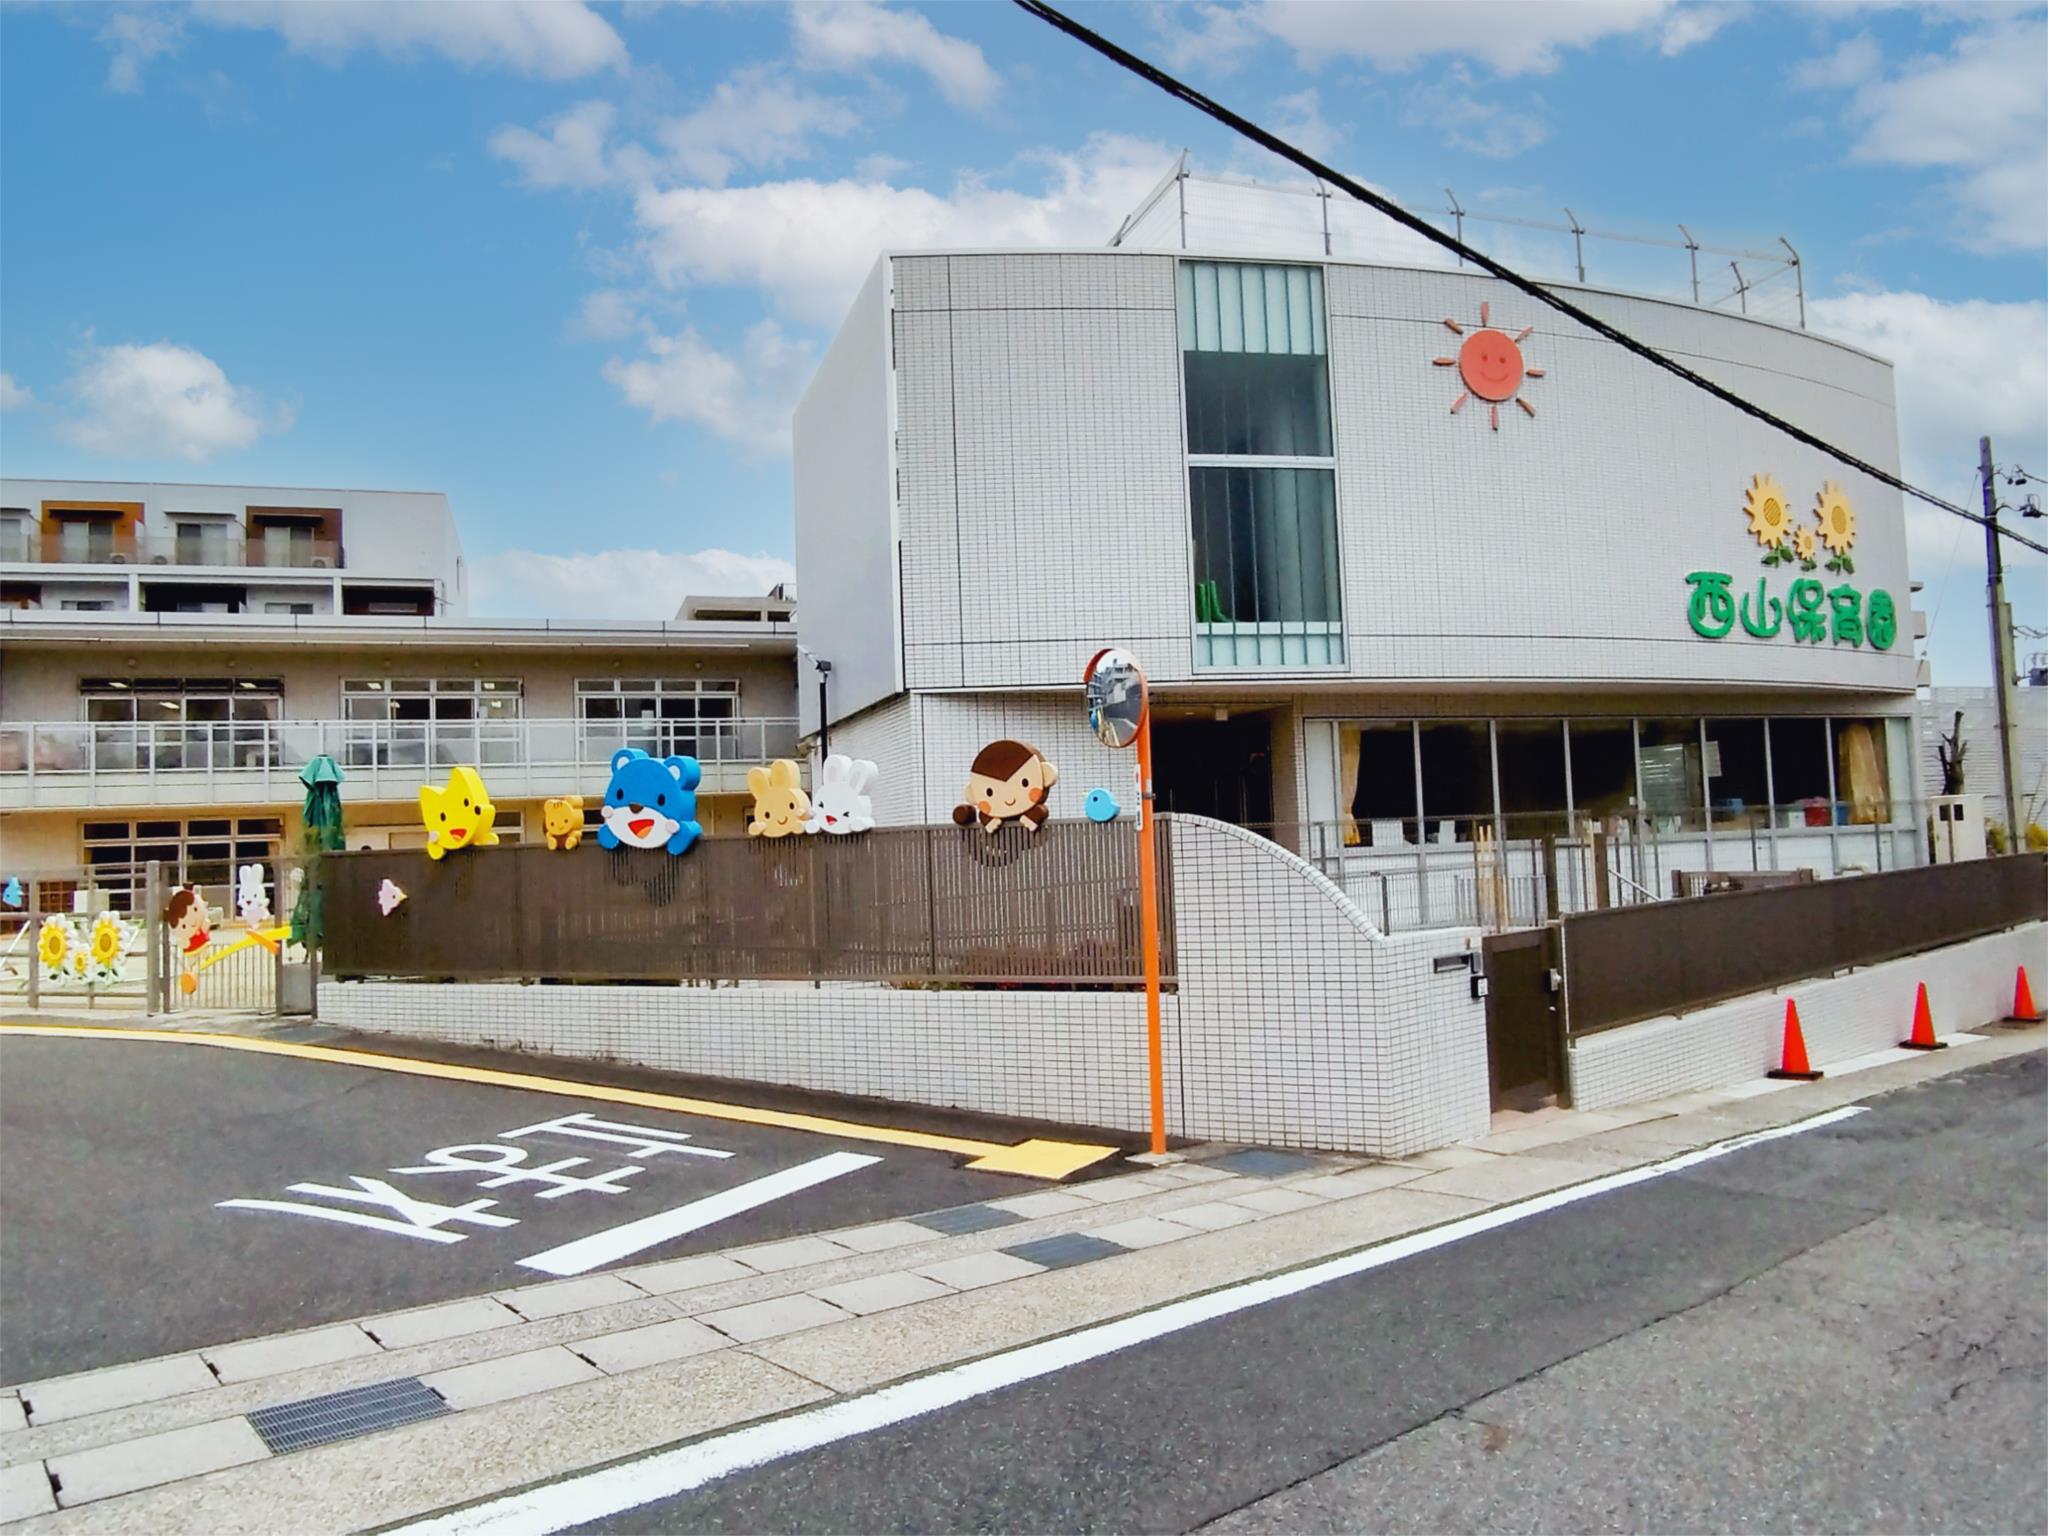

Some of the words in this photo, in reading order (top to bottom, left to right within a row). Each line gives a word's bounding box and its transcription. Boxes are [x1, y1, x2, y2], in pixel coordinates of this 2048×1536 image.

[1686, 571, 1897, 650] 西山保育園
[213, 1112, 736, 1245] 止まれ
